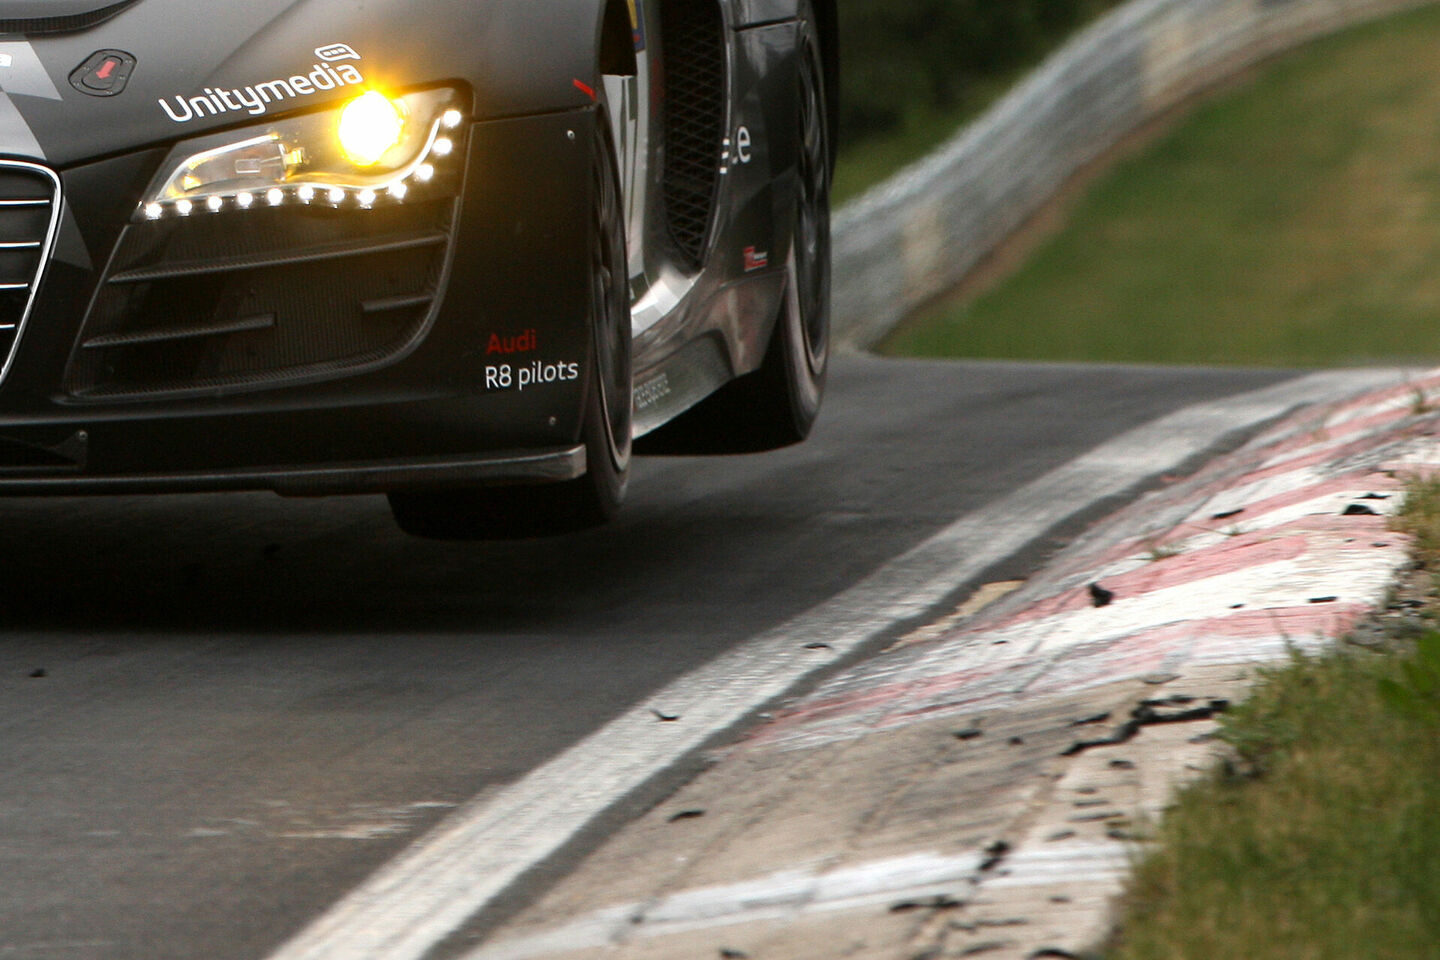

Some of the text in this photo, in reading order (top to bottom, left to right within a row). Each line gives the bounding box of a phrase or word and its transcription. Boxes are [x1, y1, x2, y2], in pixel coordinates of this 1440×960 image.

[158, 62, 364, 122] Unitymedia
[485, 328, 537, 355] Audi
[485, 359, 579, 391] R8 pilots
